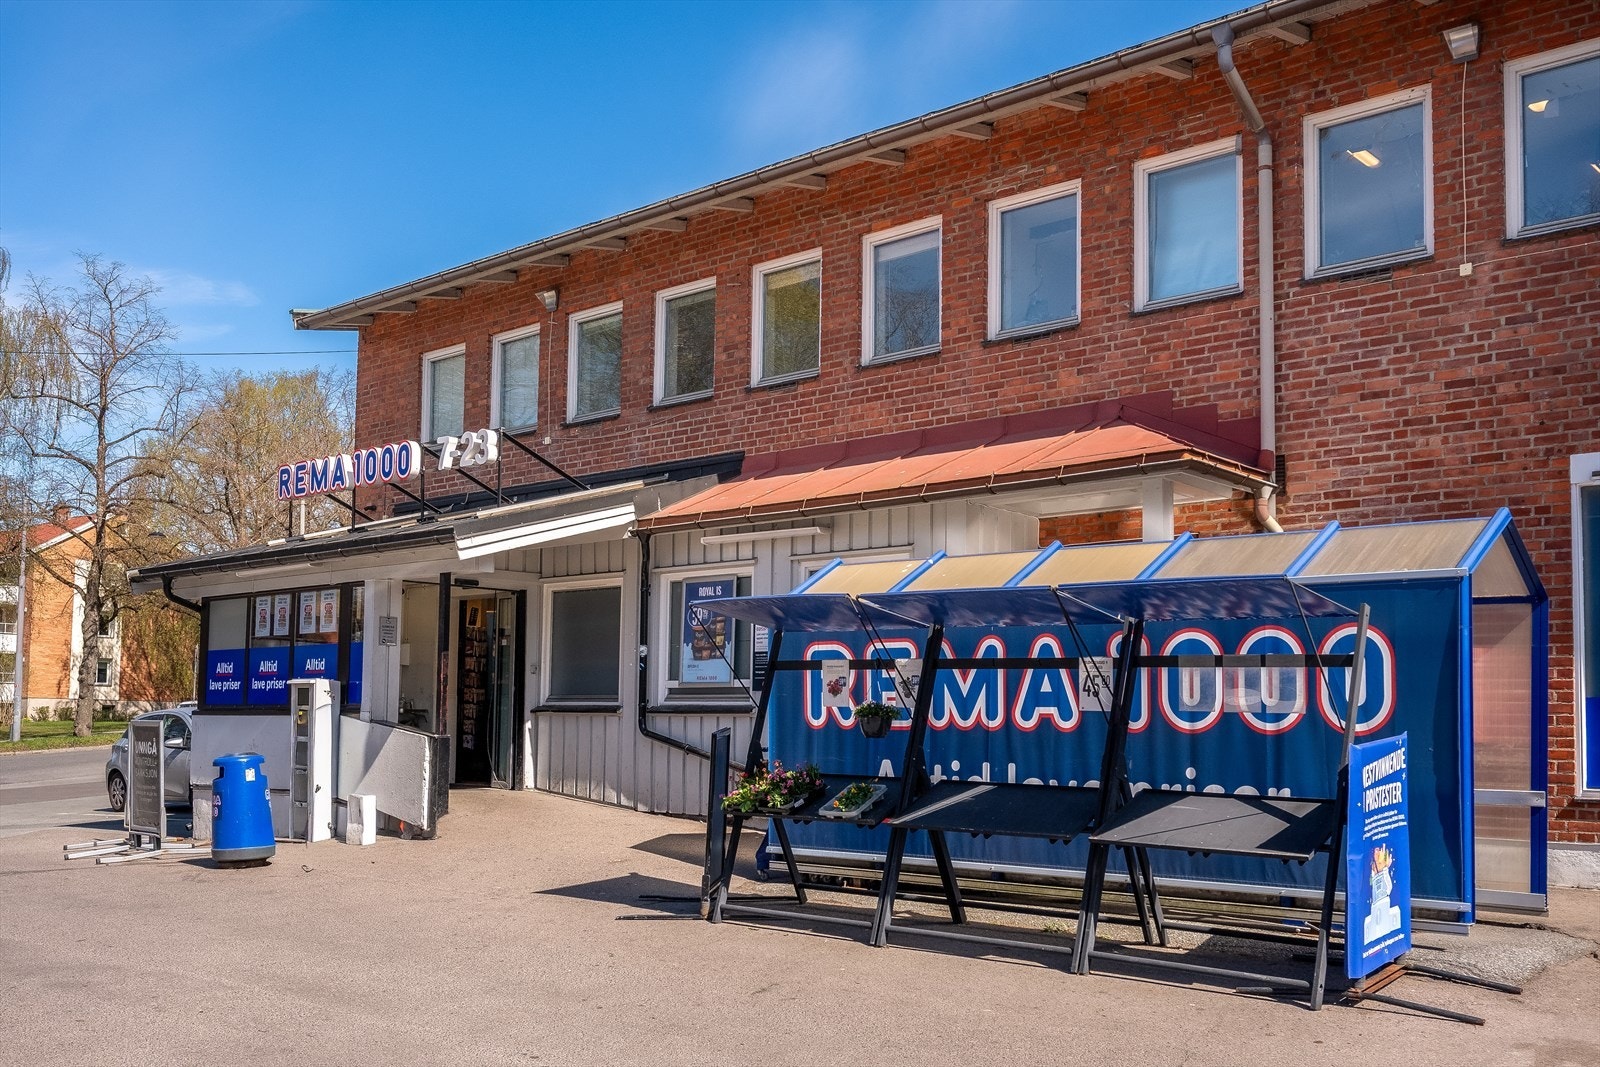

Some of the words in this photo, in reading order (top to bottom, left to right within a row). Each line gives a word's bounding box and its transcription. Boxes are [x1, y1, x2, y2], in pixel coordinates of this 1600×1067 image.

[437, 429, 497, 471] 7-23
[278, 453, 349, 500] REMA
[353, 440, 413, 486] 1000
[698, 586, 715, 597] ROYAL
[716, 585, 722, 595] IS
[216, 662, 233, 674] Alltid
[259, 660, 278, 672] Alltid
[305, 658, 325, 671] Alltid
[209, 679, 222, 691] lave
[222, 679, 241, 692] priser
[252, 678, 265, 690] lave
[266, 677, 286, 691] priser
[803, 633, 1082, 733] REMA
[1106, 622, 1396, 737] 1000
[1083, 674, 1100, 697] 45
[1365, 781, 1403, 813] PRISTESTER
